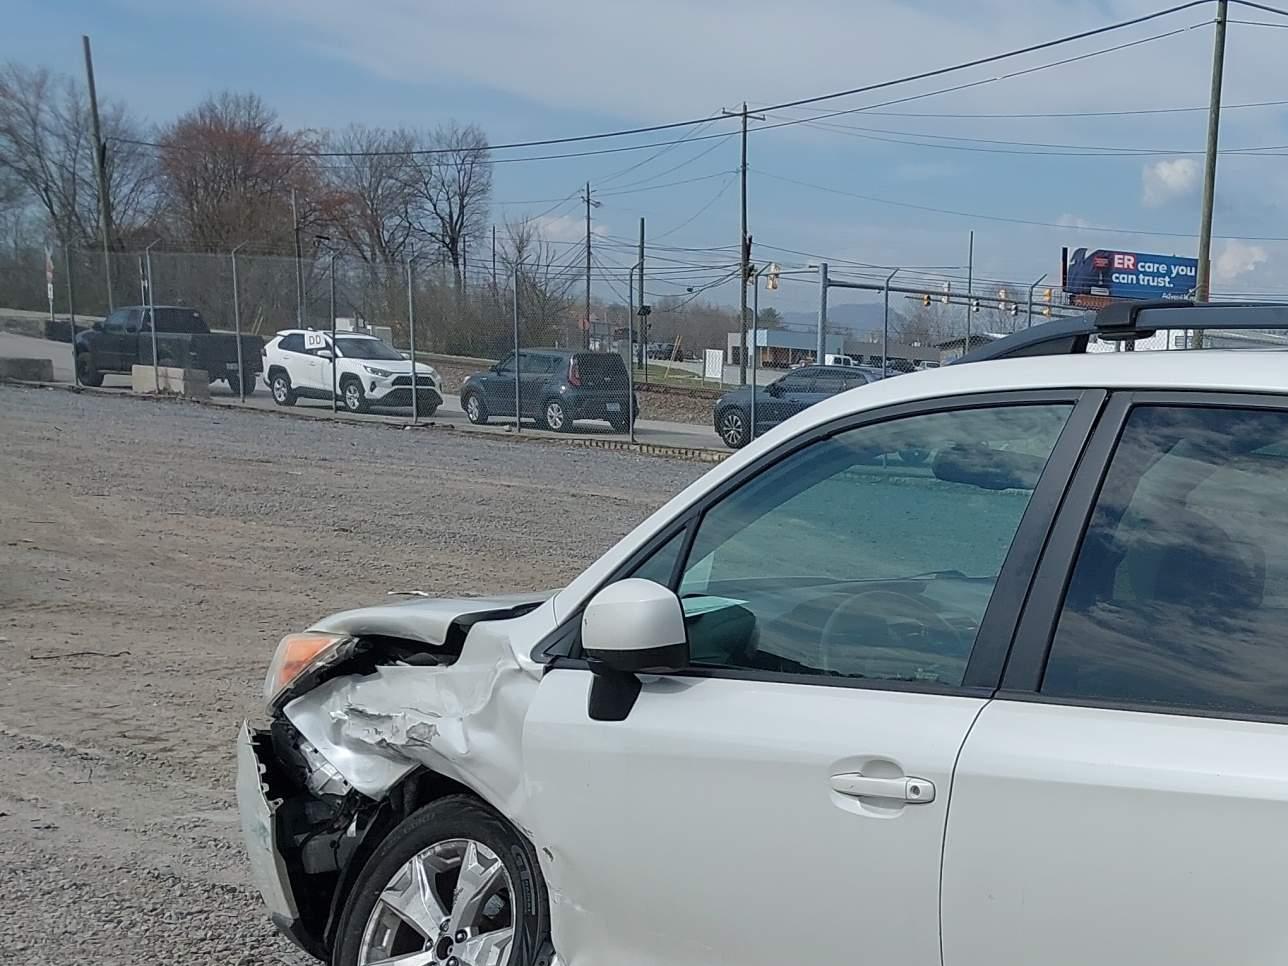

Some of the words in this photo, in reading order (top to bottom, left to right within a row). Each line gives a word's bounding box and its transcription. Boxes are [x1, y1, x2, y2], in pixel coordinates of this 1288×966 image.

[1113, 254, 1135, 270] ER
[1138, 261, 1167, 274] care
[1171, 264, 1196, 278] you
[1112, 272, 1137, 284] can
[1138, 273, 1174, 287] trust.
